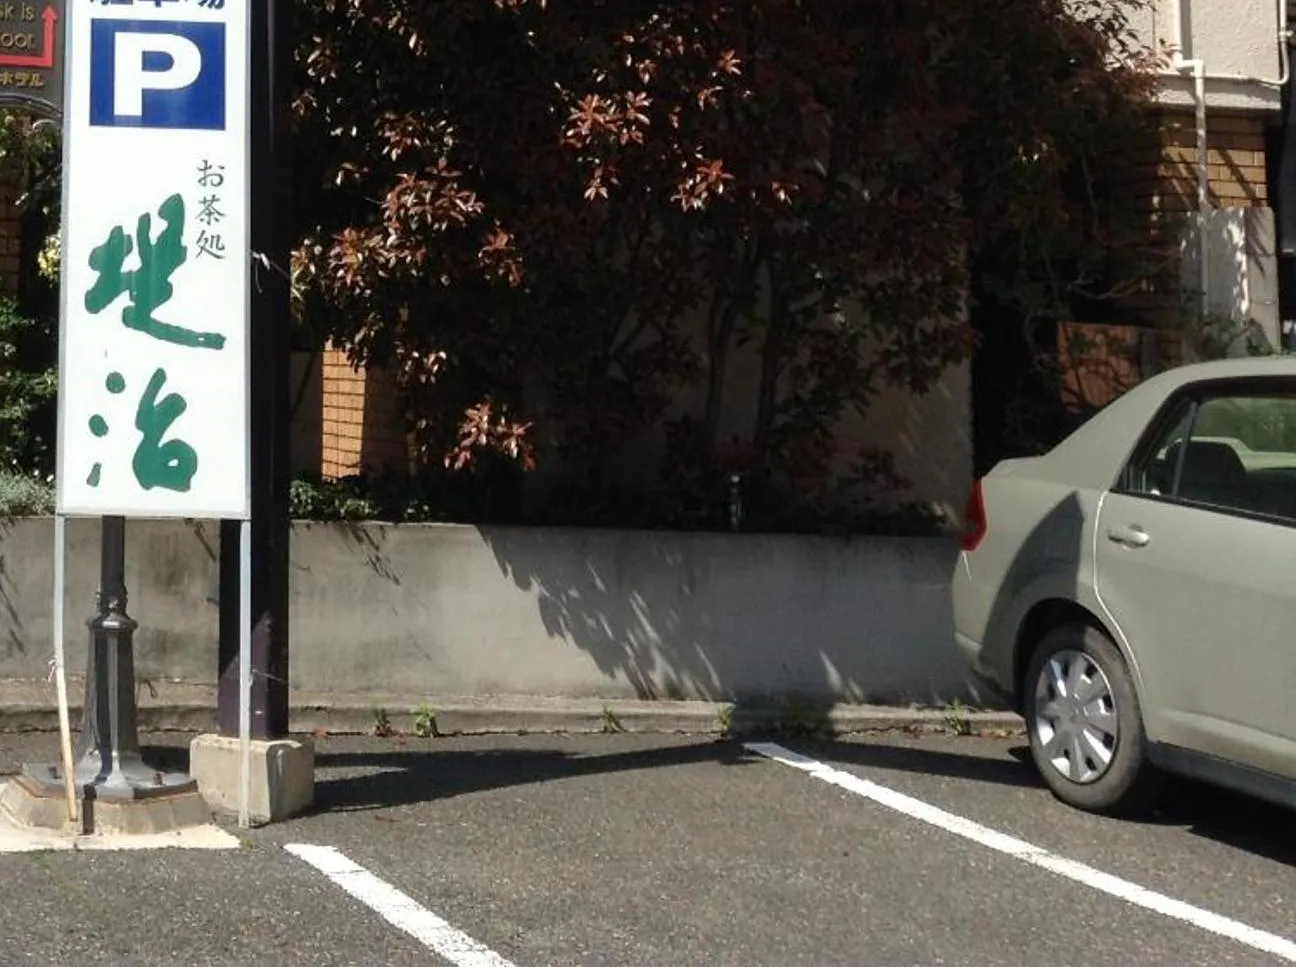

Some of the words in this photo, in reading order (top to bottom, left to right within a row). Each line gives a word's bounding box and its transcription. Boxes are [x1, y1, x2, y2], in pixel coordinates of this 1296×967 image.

[21, 2, 35, 21] is
[114, 32, 202, 116] P
[195, 159, 226, 261] お茶処
